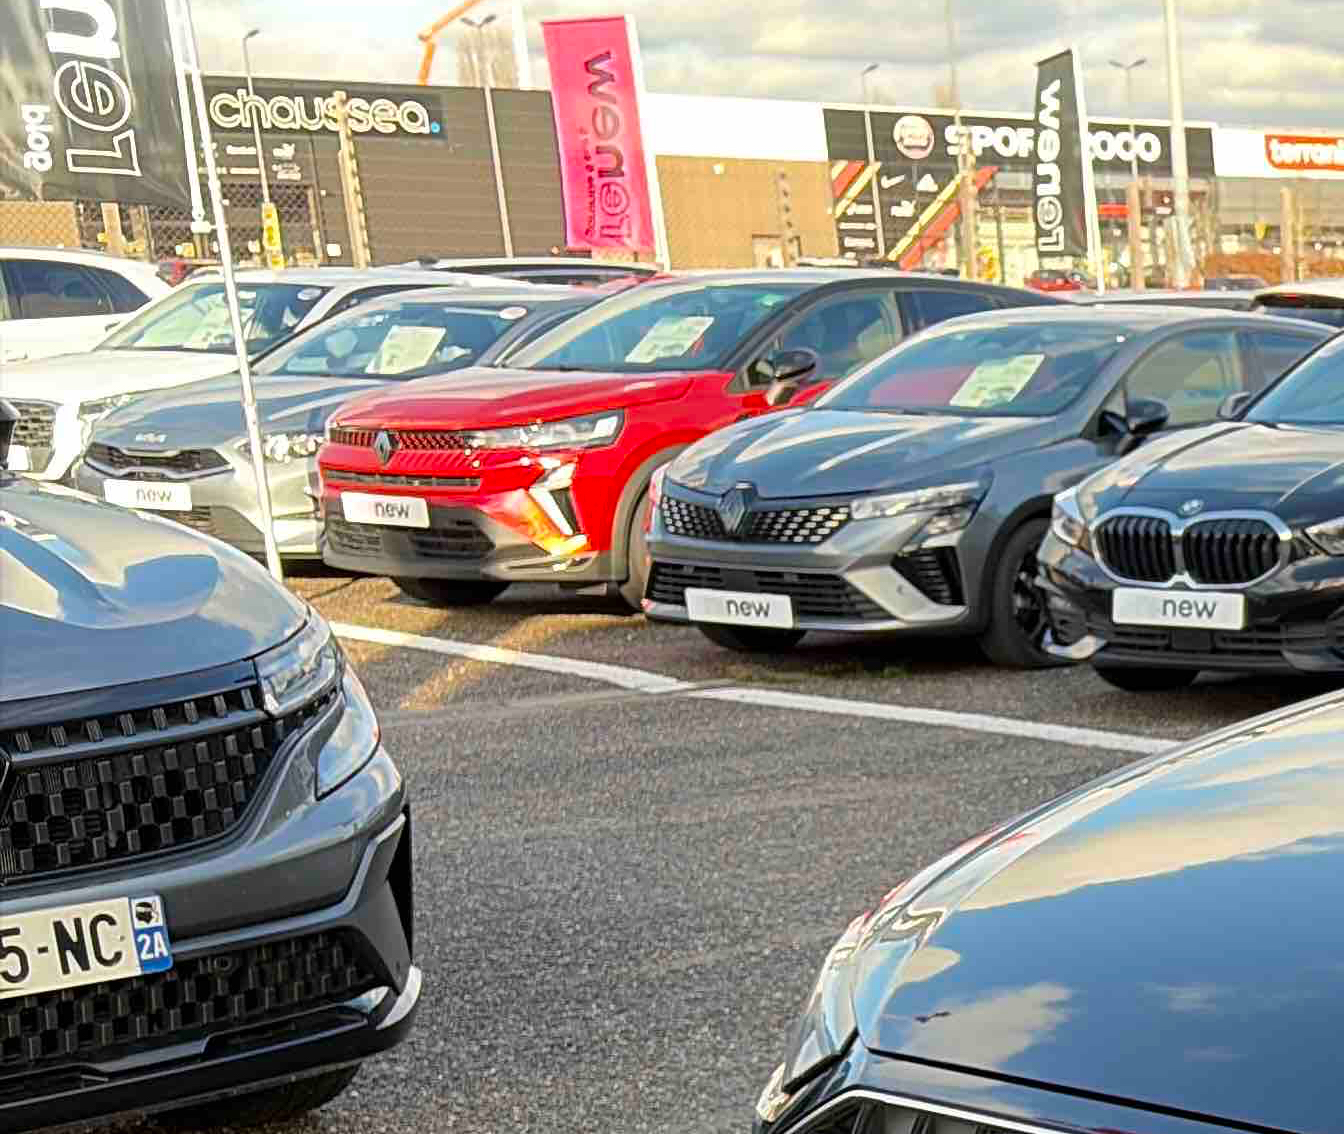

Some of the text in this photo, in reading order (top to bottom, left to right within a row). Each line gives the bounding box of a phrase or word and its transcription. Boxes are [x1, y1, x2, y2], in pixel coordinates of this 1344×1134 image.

[136, 488, 172, 503] new
[375, 502, 412, 518] new
[726, 599, 770, 618] new
[1162, 599, 1217, 619] new
[0, 914, 123, 984] 5-NC
[137, 931, 168, 960] 2A
